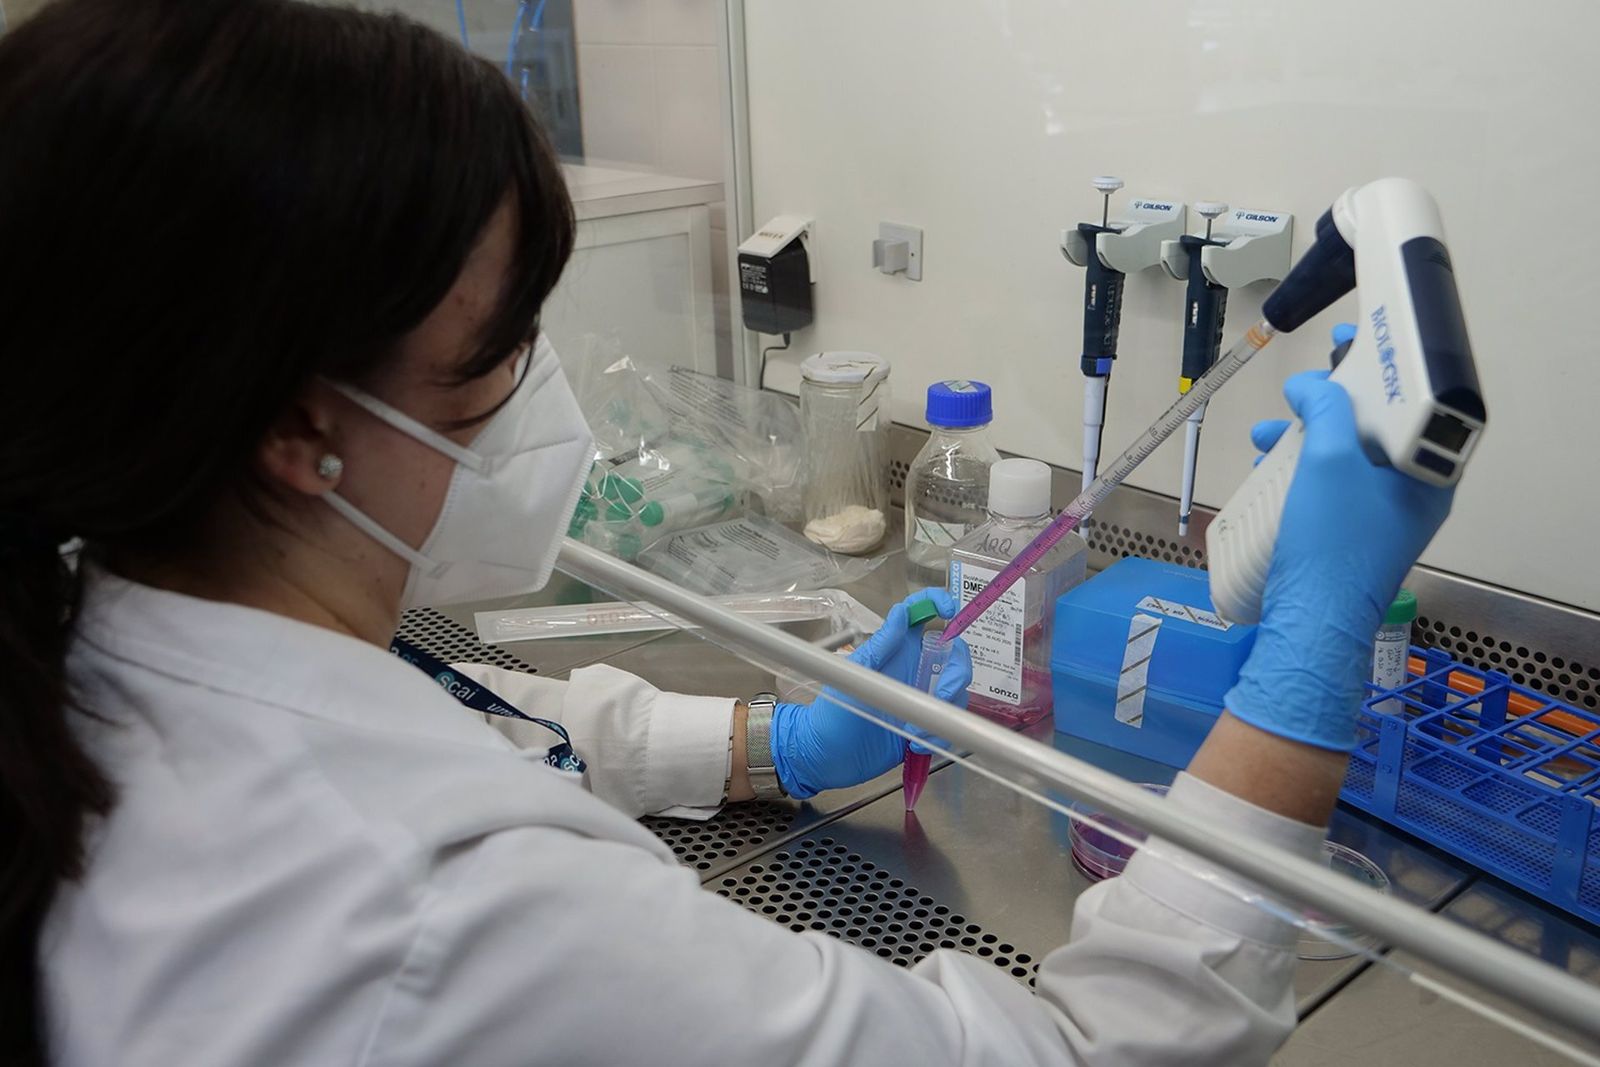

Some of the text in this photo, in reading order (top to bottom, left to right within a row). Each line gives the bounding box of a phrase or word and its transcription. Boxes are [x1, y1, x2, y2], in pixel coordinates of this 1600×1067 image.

[1143, 202, 1173, 212] GILSON
[1245, 213, 1278, 223] GILSON
[963, 580, 988, 593] DME
[989, 685, 1019, 700] Lonza
